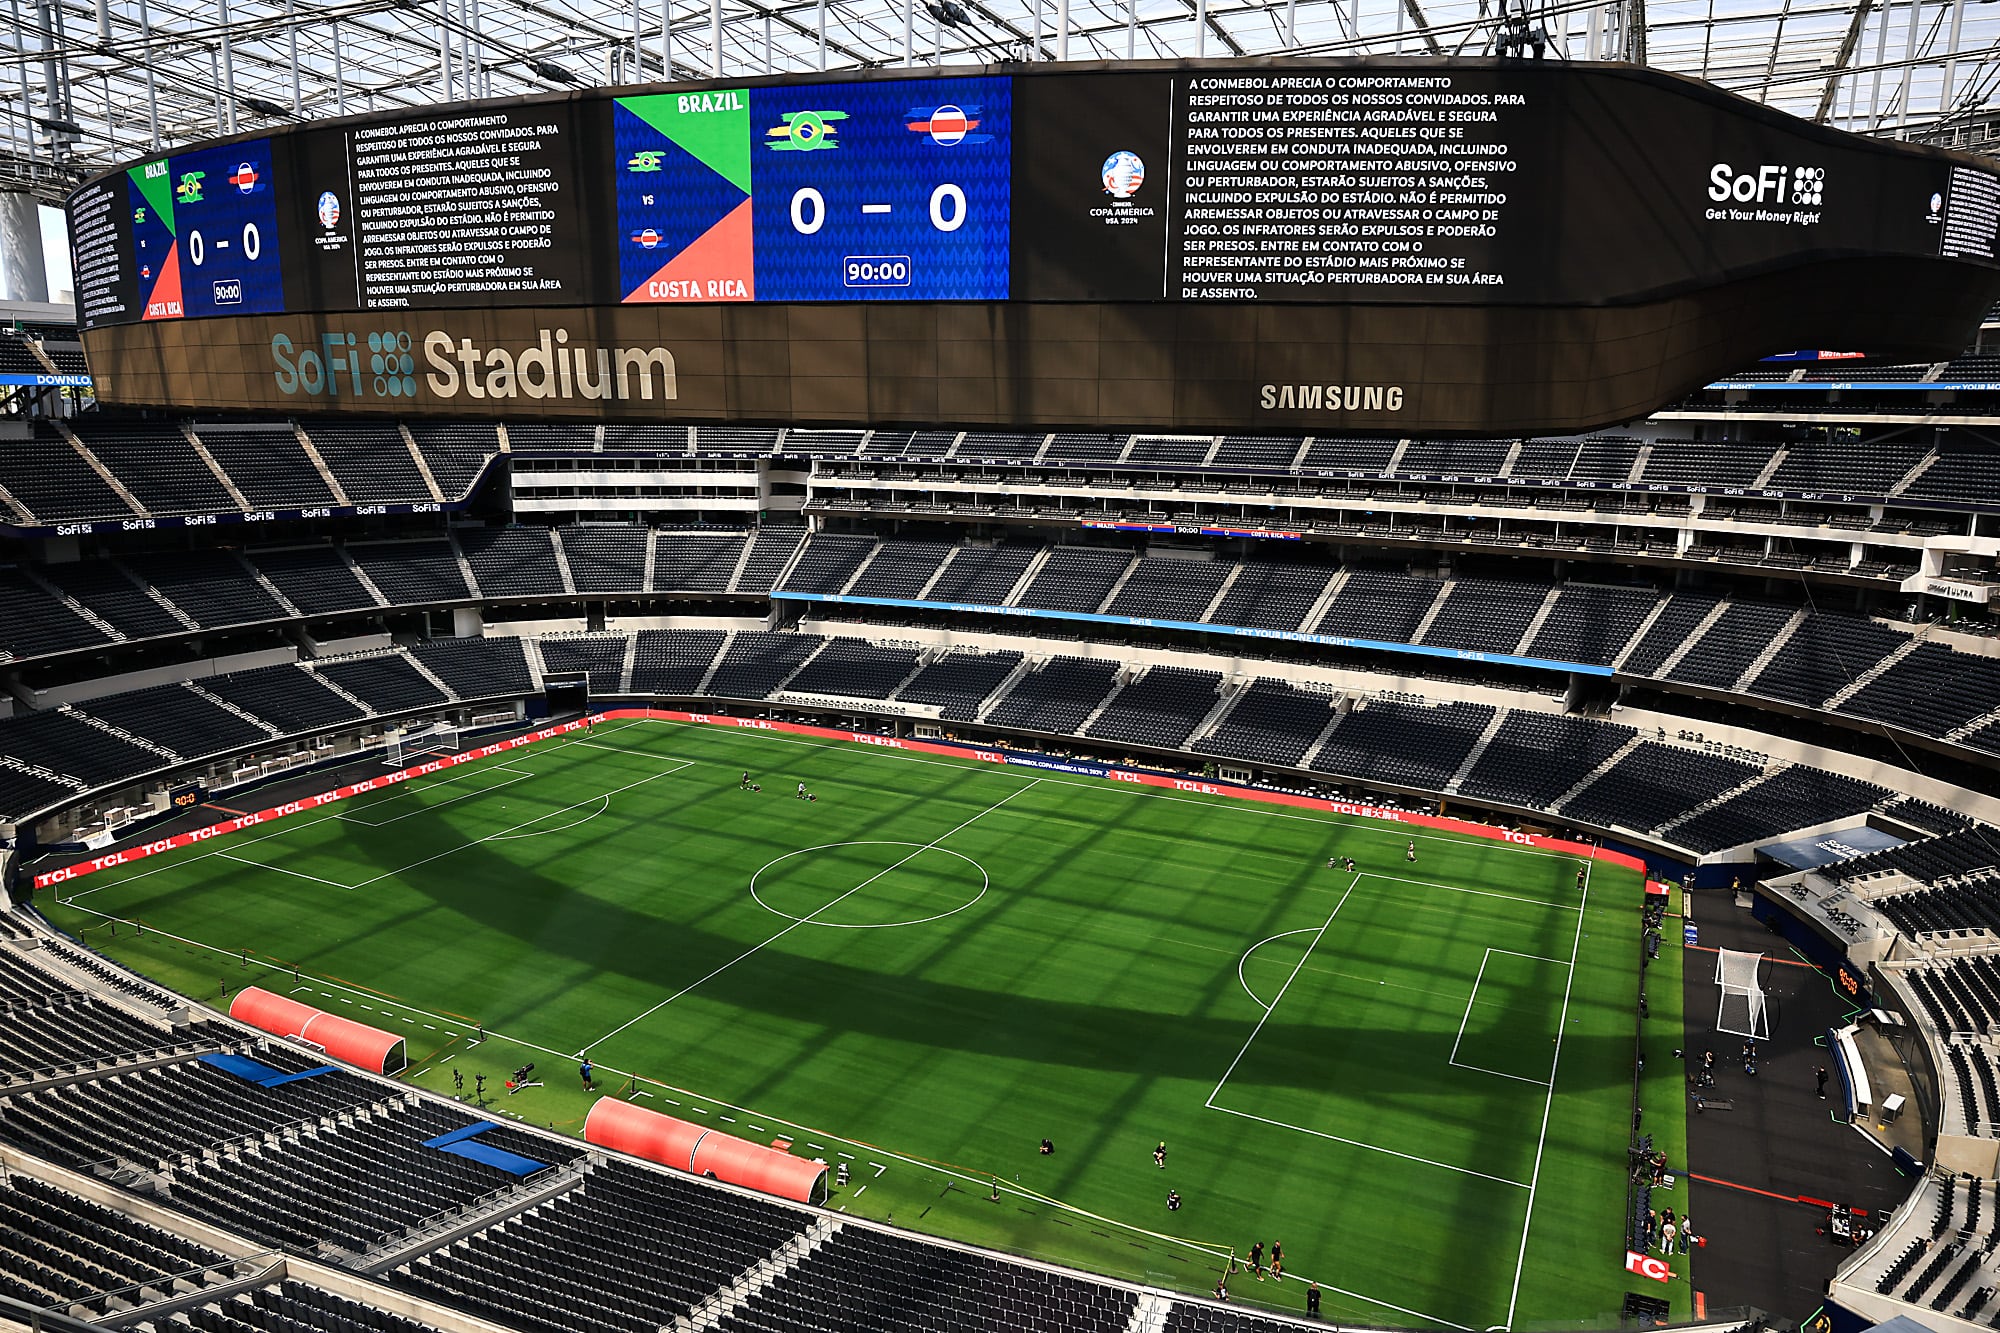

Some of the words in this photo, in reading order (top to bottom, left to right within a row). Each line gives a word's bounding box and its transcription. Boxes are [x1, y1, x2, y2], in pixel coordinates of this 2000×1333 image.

[1189, 79, 1198, 89] A
[1201, 78, 1269, 89] CONMEBOL
[1271, 77, 1322, 88] APRECIA
[1326, 78, 1335, 88] O
[1339, 77, 1451, 88] COMPORTAMENTO
[678, 92, 743, 114] BRAZIL
[1189, 94, 1263, 105] RESPEITOSO
[1267, 94, 1283, 105] DE
[1285, 94, 1328, 104] TODOS
[1331, 94, 1348, 104] OS
[1352, 94, 1402, 104] NOSSOS
[1406, 94, 1491, 104] CONVIDADOS.
[1494, 94, 1525, 104] PARA
[1188, 111, 1248, 122] GARANTIR
[1252, 111, 1279, 121] UMA
[1282, 109, 1361, 121] EXPERIÊNCIA
[1363, 109, 1435, 121] AGRADÁVEL
[1438, 111, 1445, 121] E
[1448, 111, 1497, 121] SEGURA
[1188, 128, 1219, 138] PARA
[1221, 128, 1263, 138] TODOS
[1266, 128, 1283, 138] OS
[1287, 127, 1358, 137] PRESENTES.
[1360, 127, 1416, 139] AQUELES
[1419, 128, 1445, 139] QUE
[1448, 128, 1463, 138] SE
[1188, 144, 1267, 154] ENVOLVEREM
[1271, 144, 1288, 154] EM
[1292, 143, 1350, 154] CONDUTA
[1354, 144, 1437, 156] INADEQUADA,
[1440, 144, 1507, 154] INCLUINDO
[144, 162, 168, 179] BRAZIL
[1187, 160, 1256, 170] LINGUAGEM
[1260, 160, 1278, 170] OU
[1282, 160, 1392, 170] COMPORTAMENTO
[1395, 160, 1451, 172] ABUSIVO,
[1454, 160, 1516, 171] OFENSIVO
[1186, 177, 1204, 187] OU
[1208, 176, 1298, 188] PERTURBADOR,
[1301, 174, 1355, 186] ESTARÃO
[1359, 176, 1415, 187] SUJEITOS
[1417, 177, 1426, 187] A
[1429, 175, 1488, 190] SANÇÕES,
[1708, 164, 1788, 203] SoFi
[1186, 193, 1252, 203] INCLUINDO
[1255, 191, 1317, 203] EXPULSÃO
[1321, 193, 1339, 203] DO
[1343, 191, 1396, 203] ESTÁDIO.
[1399, 191, 1426, 203] NÃO
[1429, 191, 1436, 203] É
[1440, 193, 1506, 204] PERMITIDO
[790, 187, 826, 235] 0
[930, 184, 967, 232] 0
[1090, 208, 1114, 216] COPA
[1706, 209, 1726, 221] Get
[1729, 209, 1754, 222] Your
[1756, 210, 1791, 225] Money
[190, 230, 204, 266] 0
[244, 222, 260, 260] 0
[364, 247, 383, 256] JOGO.
[384, 246, 394, 255] OS
[395, 244, 437, 254] INFRATORES
[438, 241, 462, 252] SERÃO
[464, 240, 503, 251] EXPULSOS
[505, 240, 510, 249] E
[511, 237, 551, 248] PODERÃO
[365, 261, 377, 269] SER
[378, 259, 405, 268] PRESOS.
[406, 258, 428, 267] ENTRE
[430, 257, 440, 265] EM
[442, 255, 476, 265] CONTATO
[478, 255, 495, 264] COM
[497, 254, 504, 263] O
[848, 262, 906, 281] 90:00
[216, 285, 239, 300] 90:00
[649, 280, 701, 298] COSTA
[708, 279, 748, 298] RICA
[150, 302, 166, 316] COSTA
[167, 301, 182, 315] RICA
[272, 332, 363, 398] SoFi
[424, 328, 678, 401] Stadium
[1261, 384, 1403, 411] SAMSUNG
[301, 508, 321, 519] SoFi
[356, 506, 376, 516] SoFi
[412, 504, 431, 513] SoFi
[184, 516, 206, 526] SoFi
[244, 512, 264, 522] SoFi
[57, 524, 80, 536] SoFi
[122, 519, 144, 530] SoFi
[1178, 526, 1198, 534] 90:00
[1234, 628, 1254, 636] GET
[1255, 630, 1281, 639] YOUR
[1282, 631, 1317, 642] MONEY
[1457, 650, 1475, 659] SoFi
[589, 714, 607, 724] TCL
[689, 714, 710, 723] TCL
[737, 718, 758, 728] TCL
[564, 721, 582, 732] TCL
[538, 729, 557, 739] TCL
[852, 733, 874, 744] TCL
[510, 736, 530, 748] TCL
[481, 744, 502, 756] TCL
[975, 751, 998, 762] TCL
[451, 753, 474, 765] TCL
[420, 762, 443, 774] TCL
[386, 771, 410, 783] TCL
[1115, 771, 1141, 782] TCL
[351, 780, 377, 794] TCL
[1174, 780, 1201, 792] TCL
[314, 790, 341, 805] TCL
[274, 801, 303, 816] TCL
[1331, 803, 1360, 816] TCL
[233, 813, 263, 829] TCL
[189, 825, 221, 842] TCL
[1502, 830, 1535, 845] TCL
[142, 838, 177, 855] TCL
[91, 852, 128, 870] TCL
[38, 867, 77, 886] TCL
